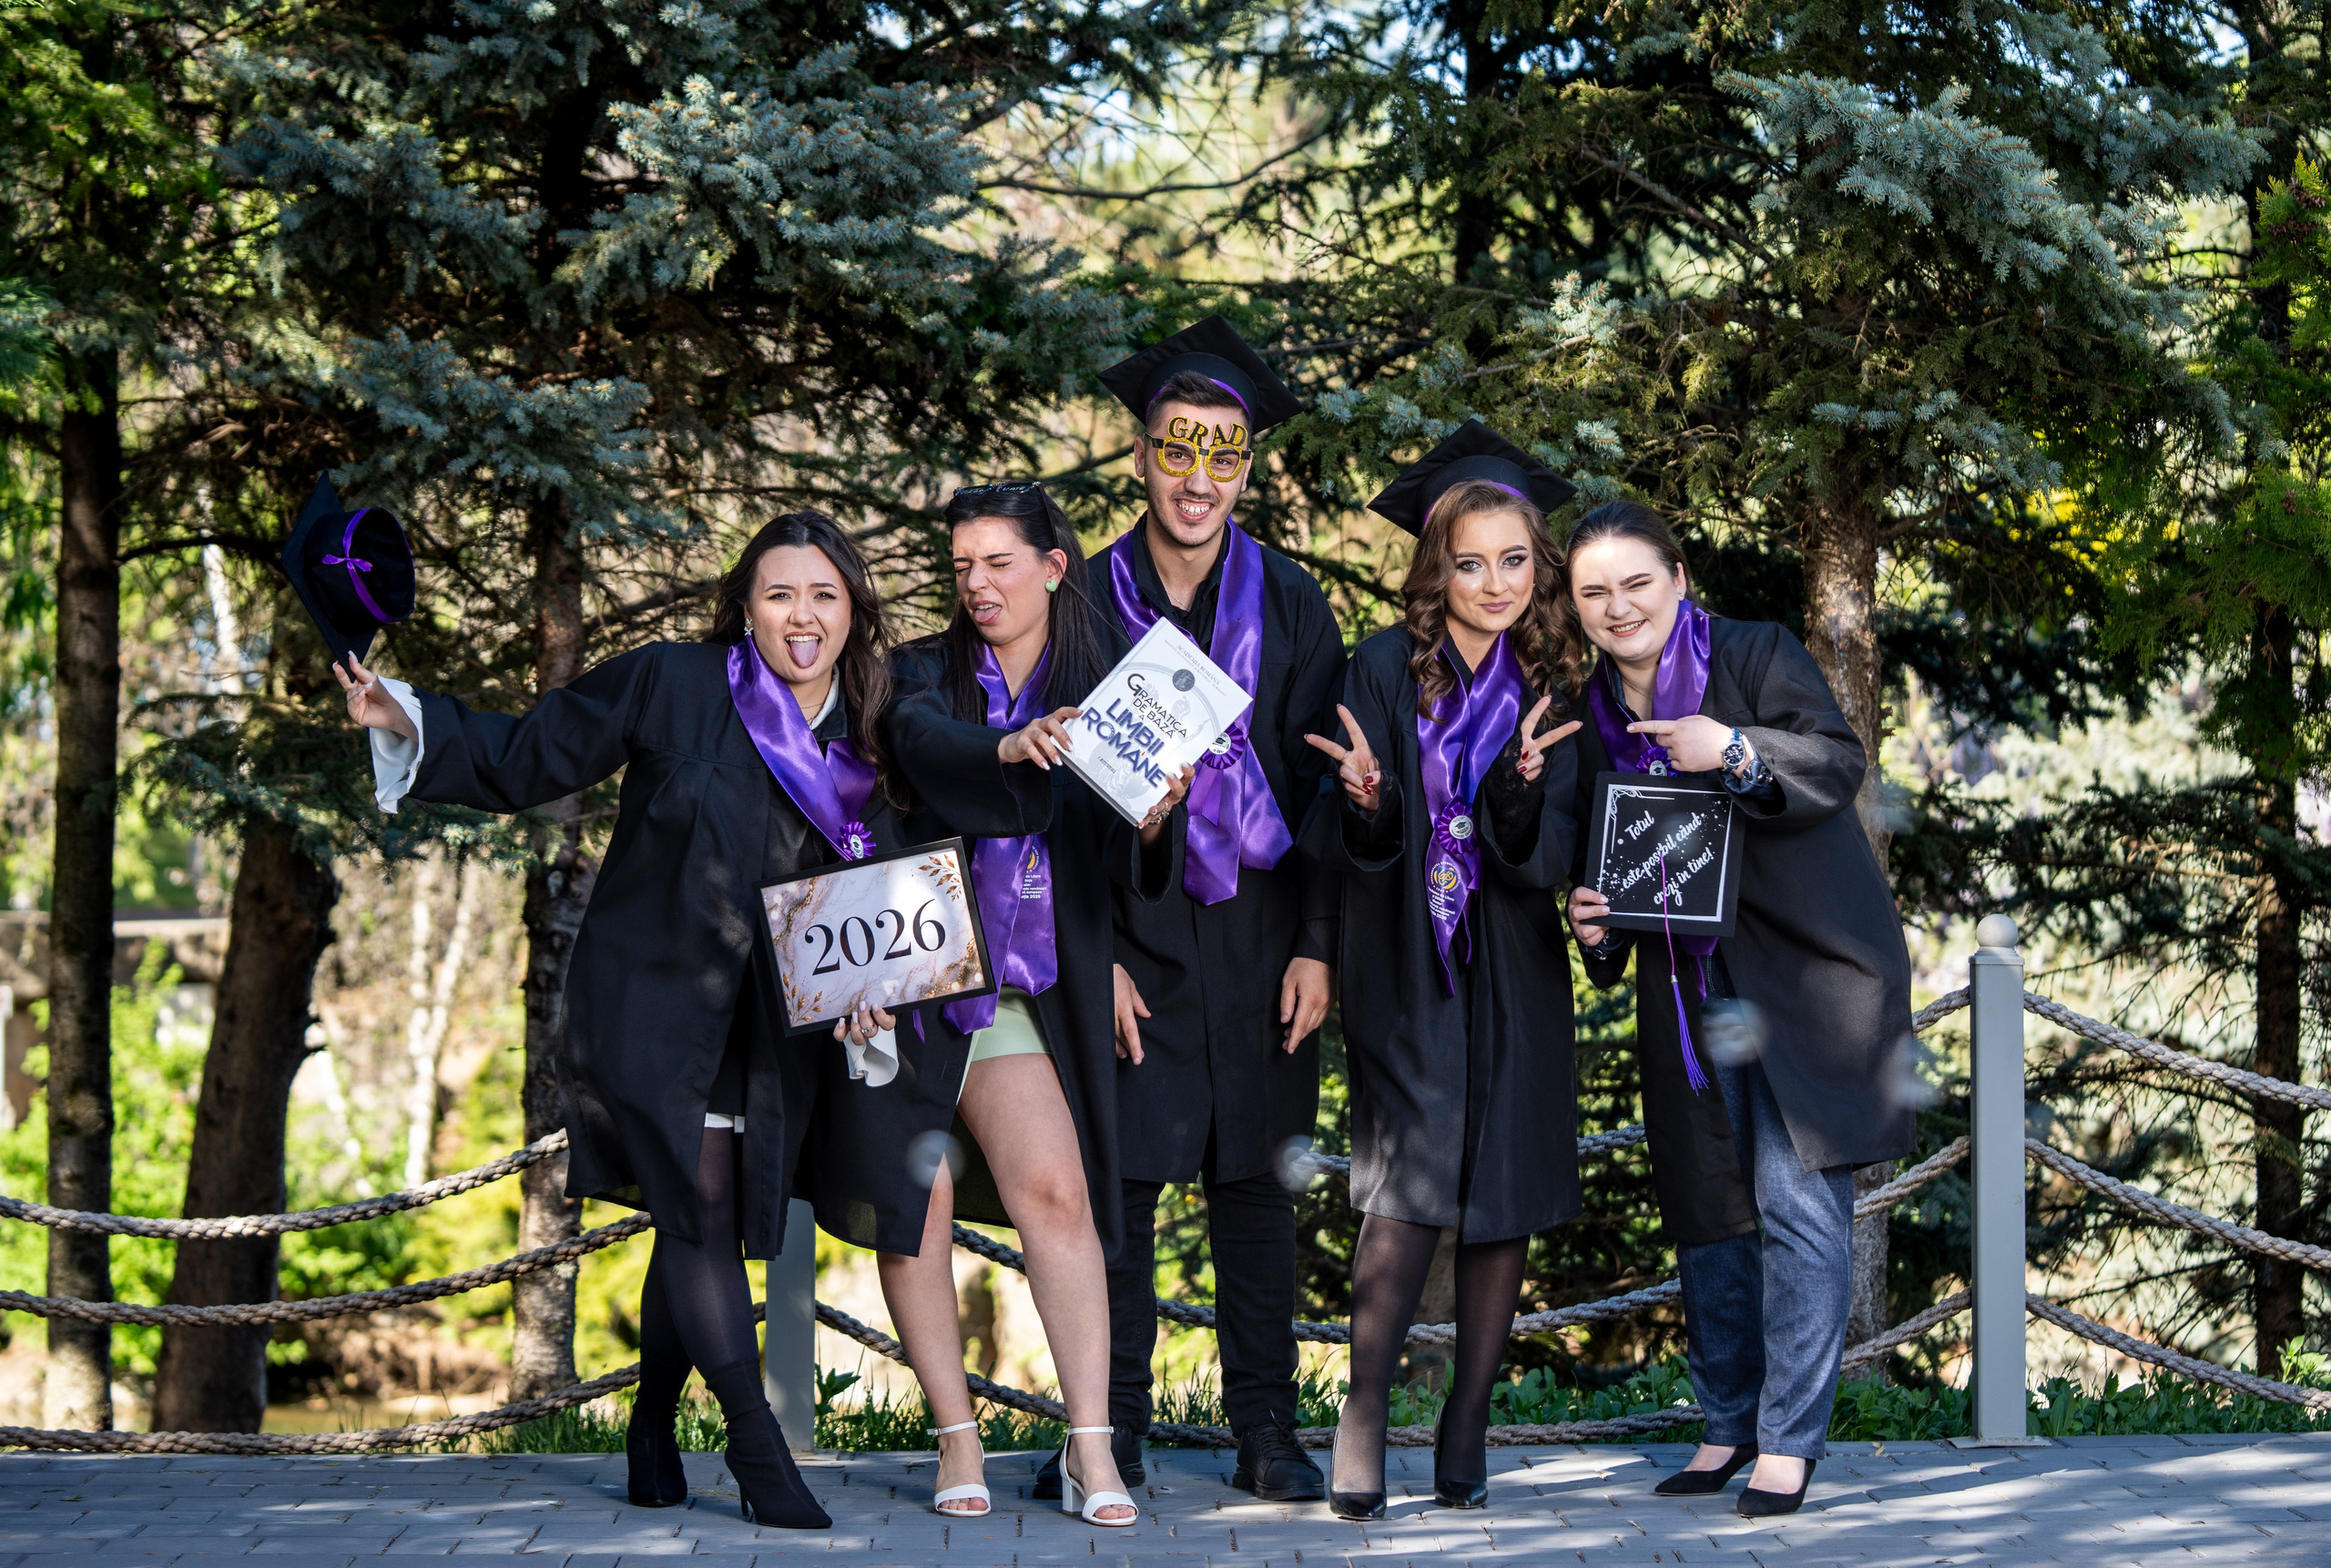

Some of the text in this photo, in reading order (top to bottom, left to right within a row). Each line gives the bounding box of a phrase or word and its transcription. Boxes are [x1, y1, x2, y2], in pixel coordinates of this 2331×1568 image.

[1168, 416, 1247, 447] GRAD
[1105, 697, 1165, 756] LIMBII
[1127, 673, 1187, 738] GRAMATICA
[1133, 697, 1148, 714] DE
[1624, 809, 1654, 840] Totul
[1623, 867, 1644, 889] este
[1675, 811, 1702, 842] când
[1686, 846, 1715, 873] tine!
[805, 898, 946, 975] 2026
